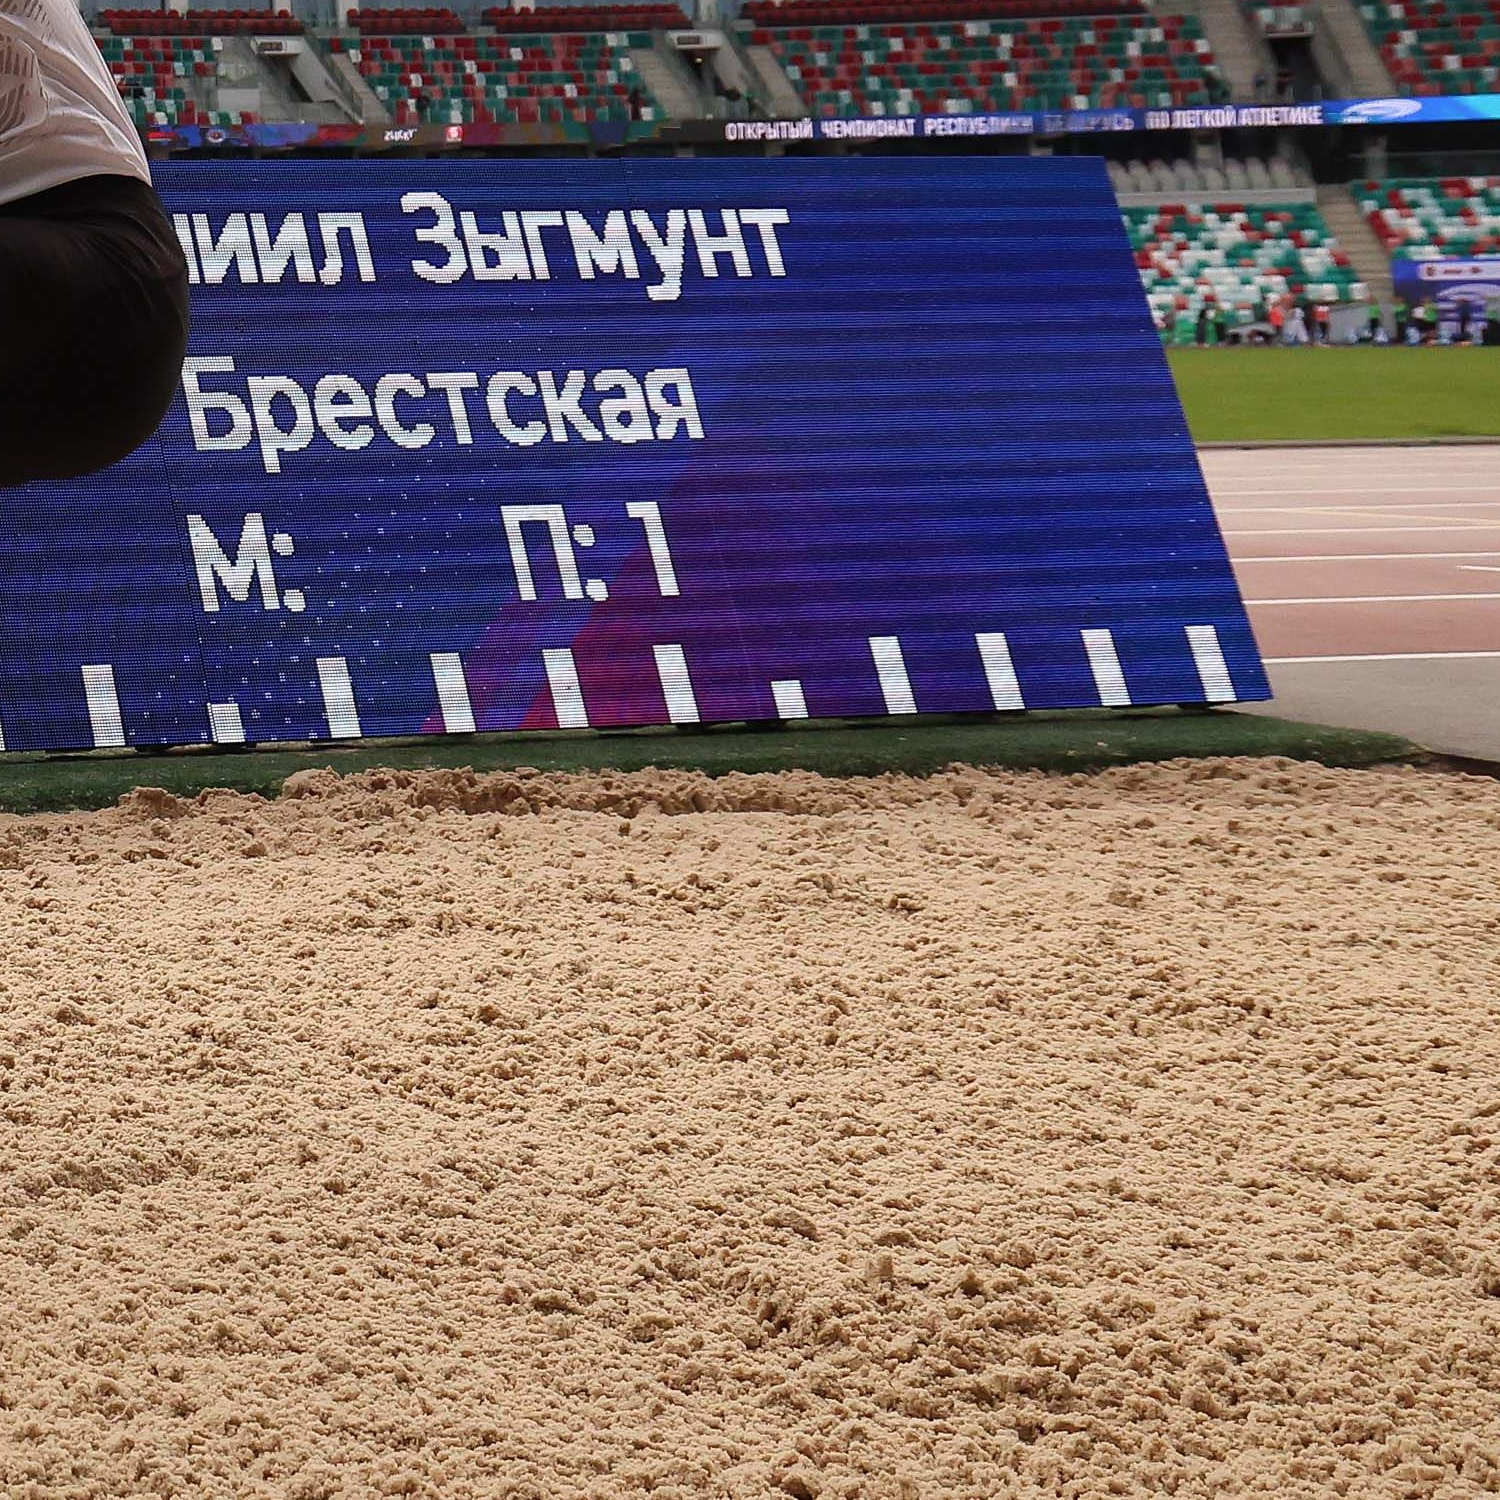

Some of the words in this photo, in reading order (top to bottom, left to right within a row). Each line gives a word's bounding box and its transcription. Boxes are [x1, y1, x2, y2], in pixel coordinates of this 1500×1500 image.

[725, 117, 813, 140] ОТКРЫТЫЙ
[821, 118, 915, 139] ЧЕМПИОНАТ
[1145, 111, 1170, 129] ПО
[1238, 106, 1323, 126] АТЛЕТИКЕ
[400, 192, 790, 301] Зыгмунт
[180, 355, 705, 473] Брестская
[186, 513, 305, 613] М:
